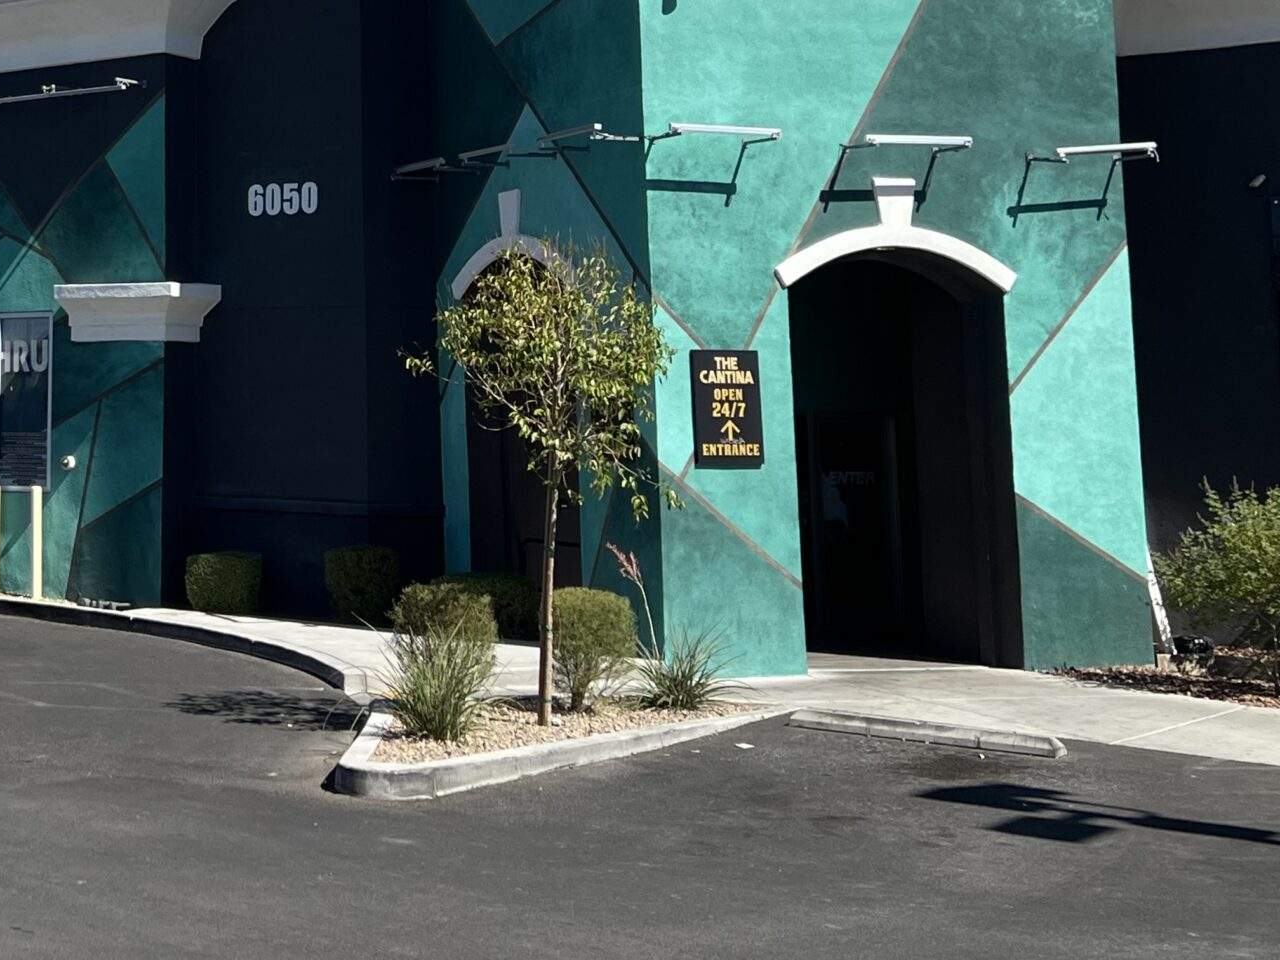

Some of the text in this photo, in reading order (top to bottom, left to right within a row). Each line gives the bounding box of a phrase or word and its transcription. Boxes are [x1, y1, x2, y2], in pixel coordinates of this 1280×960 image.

[247, 181, 318, 217] 6050
[714, 356, 739, 370] THE
[699, 370, 755, 385] CANTINA
[713, 388, 743, 401] OPEN
[711, 401, 746, 418] 24/7
[702, 443, 761, 457] ENTRANCE
